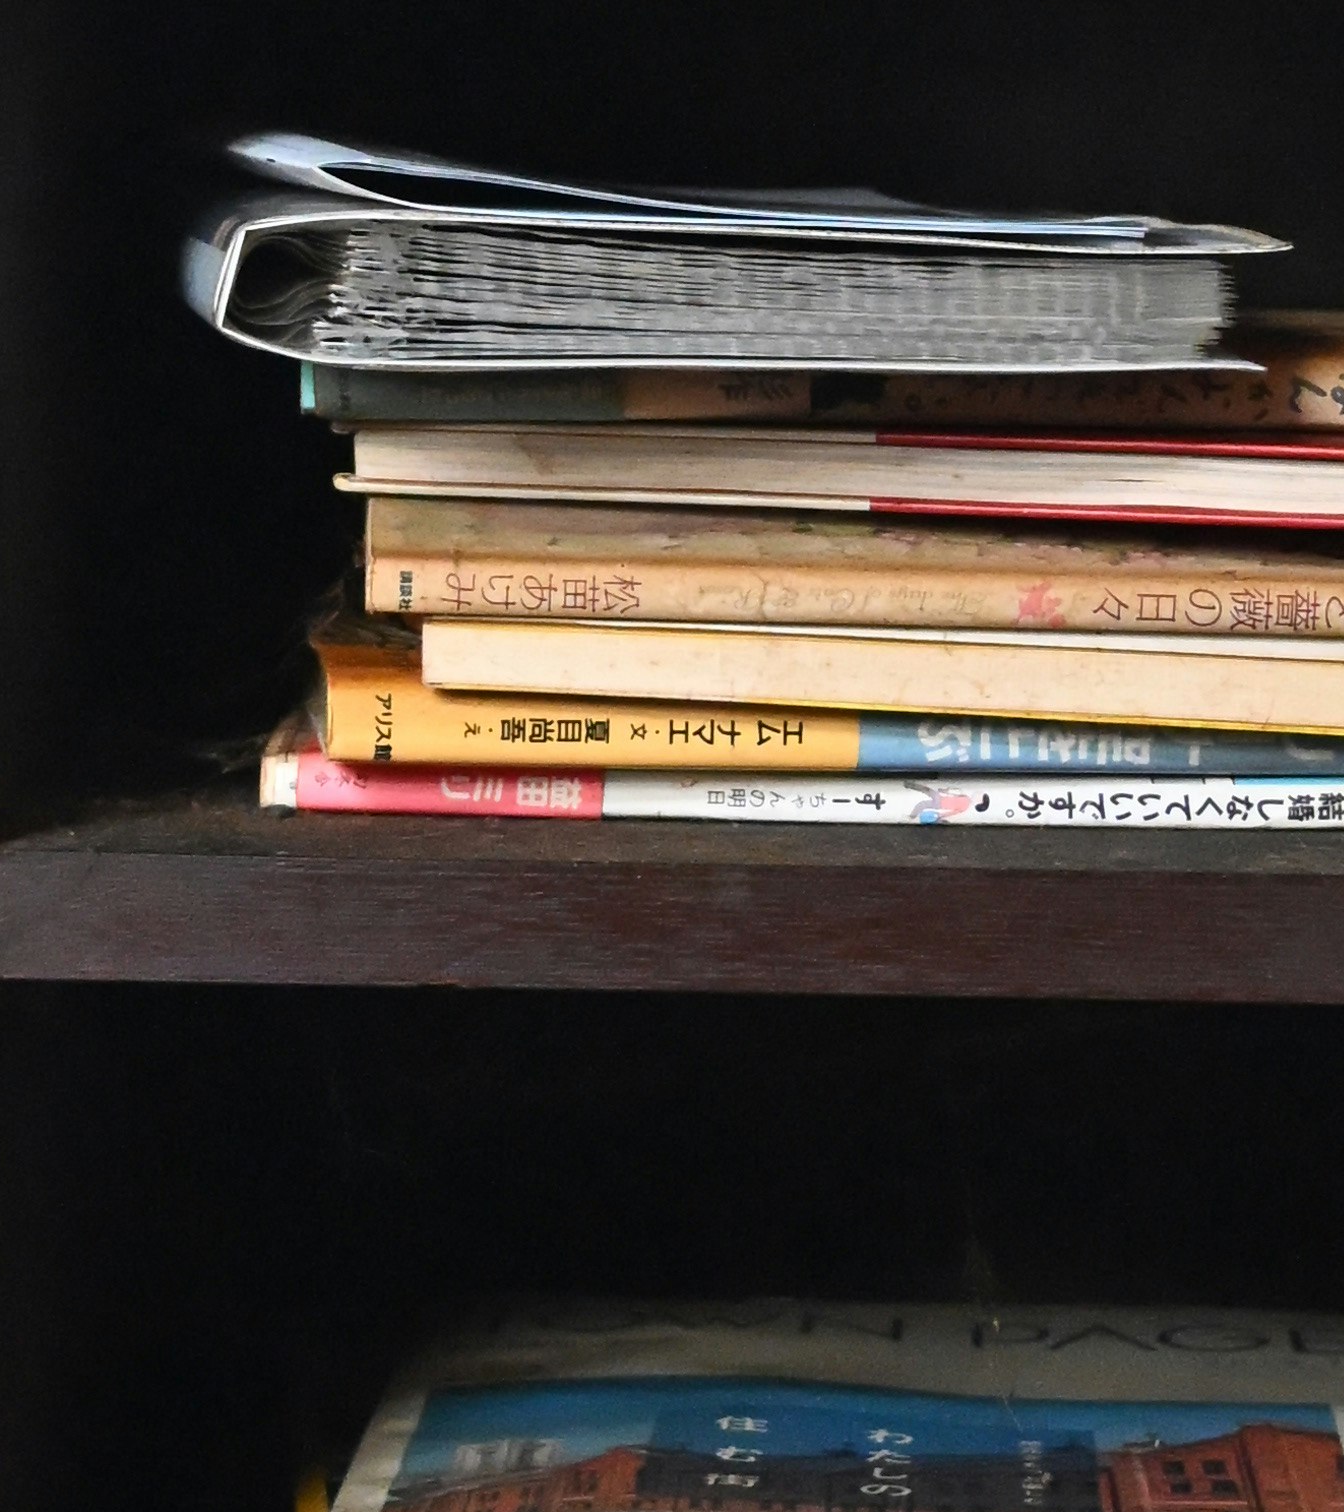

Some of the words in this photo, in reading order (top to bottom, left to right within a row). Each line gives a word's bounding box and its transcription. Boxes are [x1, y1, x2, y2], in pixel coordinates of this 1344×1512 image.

[398, 571, 414, 612] 講談社
[440, 574, 642, 613] 松苗あけみ
[706, 789, 886, 812] すーちゃんの明日
[859, 1427, 914, 1497] わたしの
